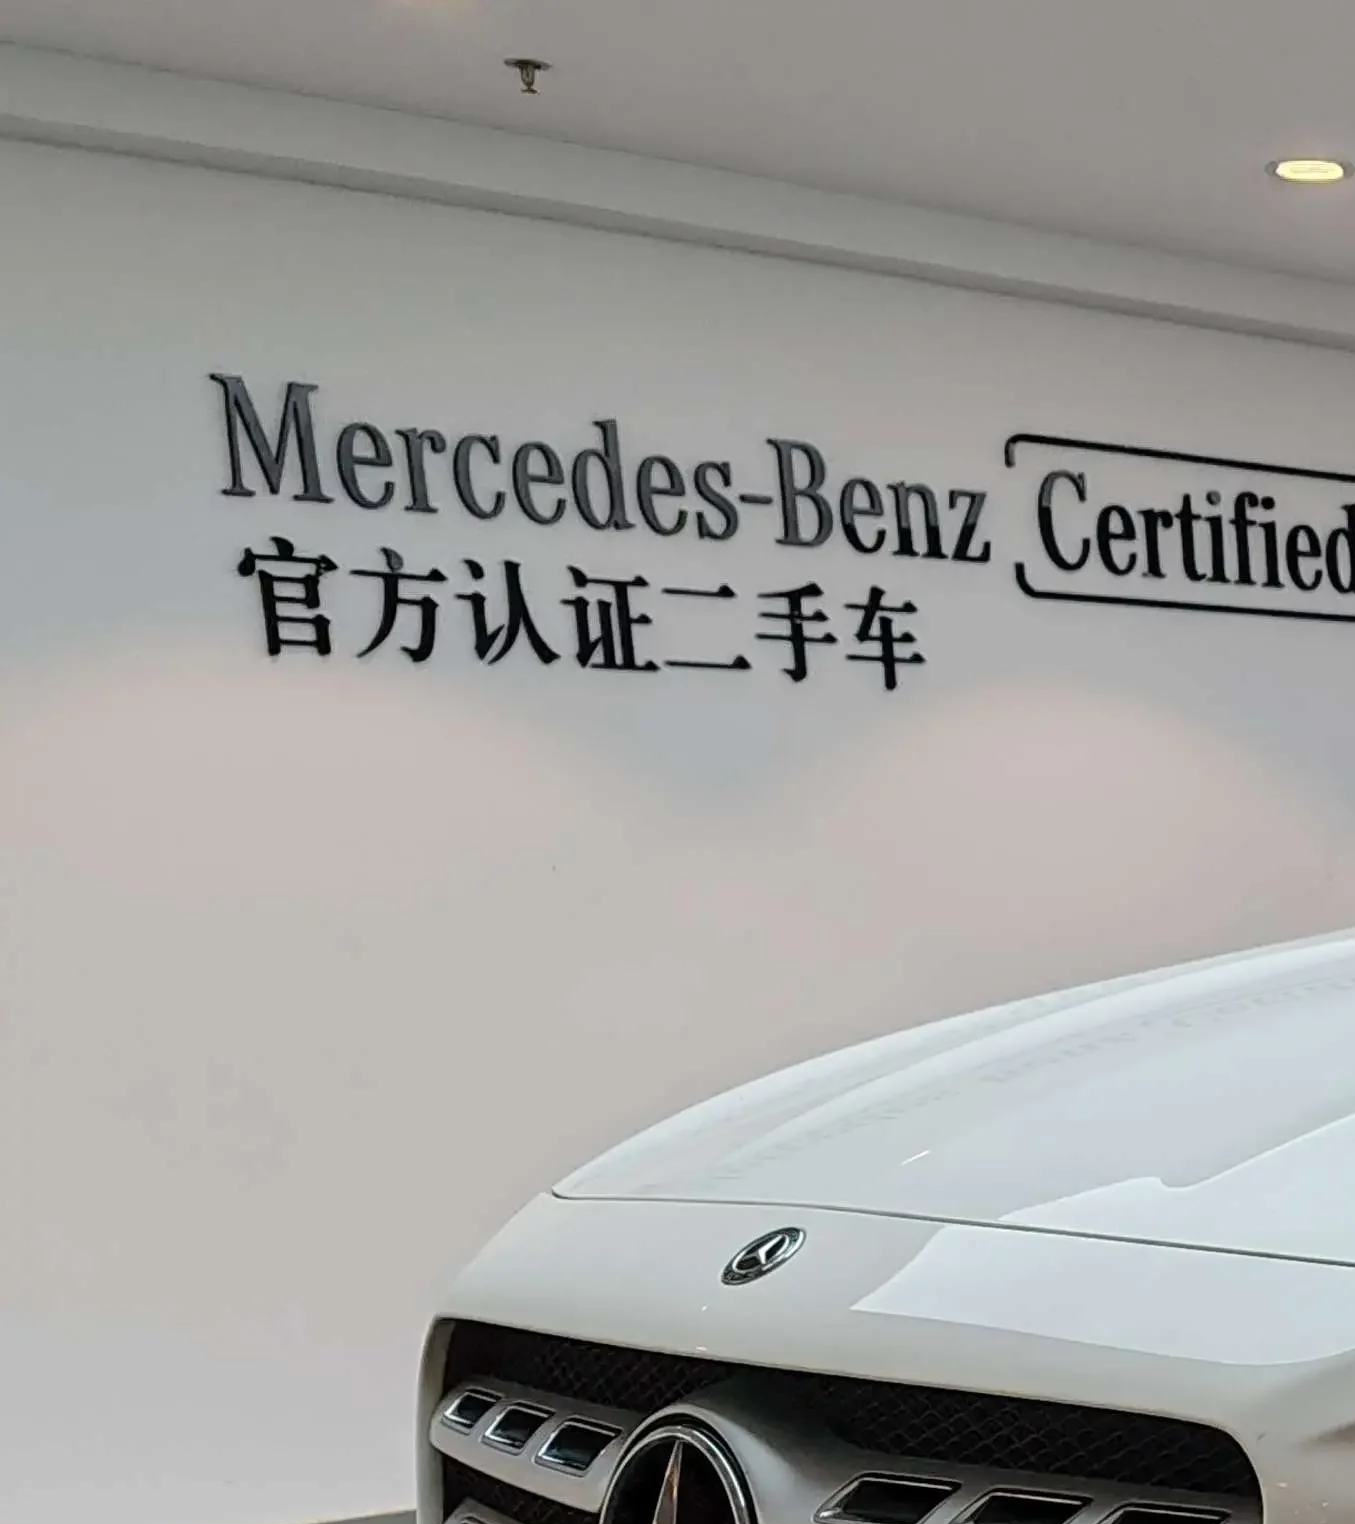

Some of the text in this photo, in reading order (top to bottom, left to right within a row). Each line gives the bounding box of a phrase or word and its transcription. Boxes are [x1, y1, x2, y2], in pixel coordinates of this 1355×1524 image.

[208, 373, 991, 564] Mercedes-Benz
[236, 535, 926, 691] 官方认证二手车
